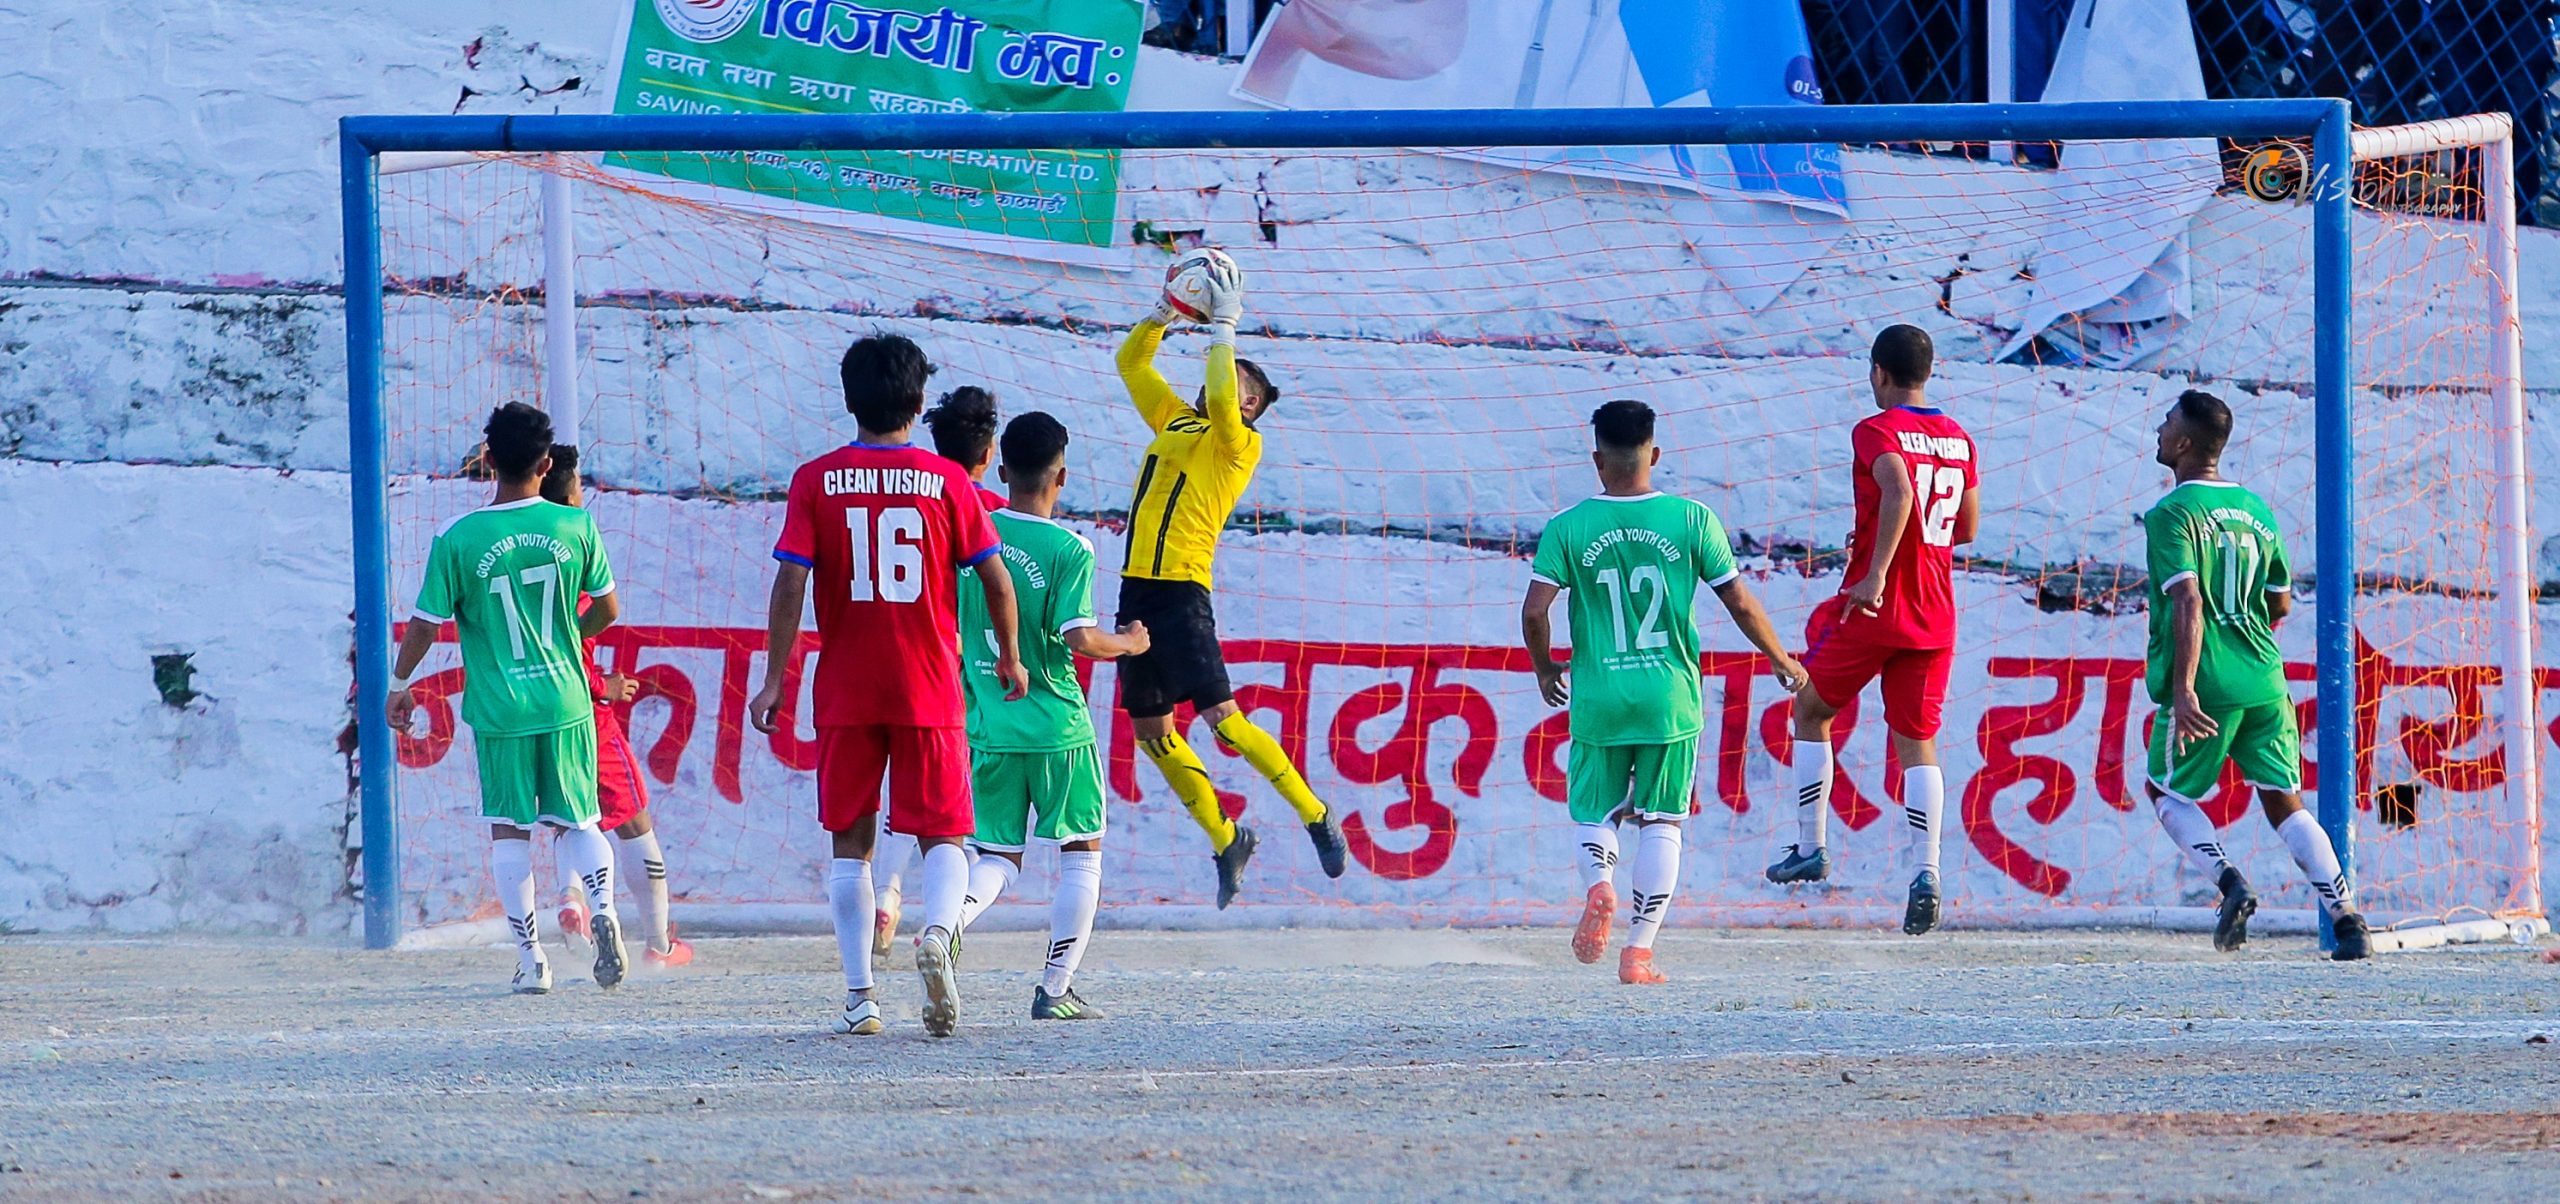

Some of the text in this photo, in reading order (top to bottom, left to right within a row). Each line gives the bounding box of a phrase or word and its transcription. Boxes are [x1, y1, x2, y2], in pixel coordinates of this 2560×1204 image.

[645, 47, 711, 77] बचत
[722, 62, 777, 89] तथा
[789, 75, 856, 103] ऋण
[1056, 162, 1100, 181] LTD.
[1896, 430, 1936, 456] CLEAN
[823, 468, 945, 500] CLEAN VISION
[1915, 463, 1965, 547] 12
[845, 506, 924, 603] 16
[1582, 527, 1682, 568] GOLD STAR YOUTH CLUB
[2254, 520, 2275, 542] CLUB
[477, 533, 573, 579] GOLD STAR YOUTH CLUB
[1002, 542, 1046, 590] YOUTH CLUB
[489, 562, 557, 661] 17
[1596, 565, 1669, 653] 12
